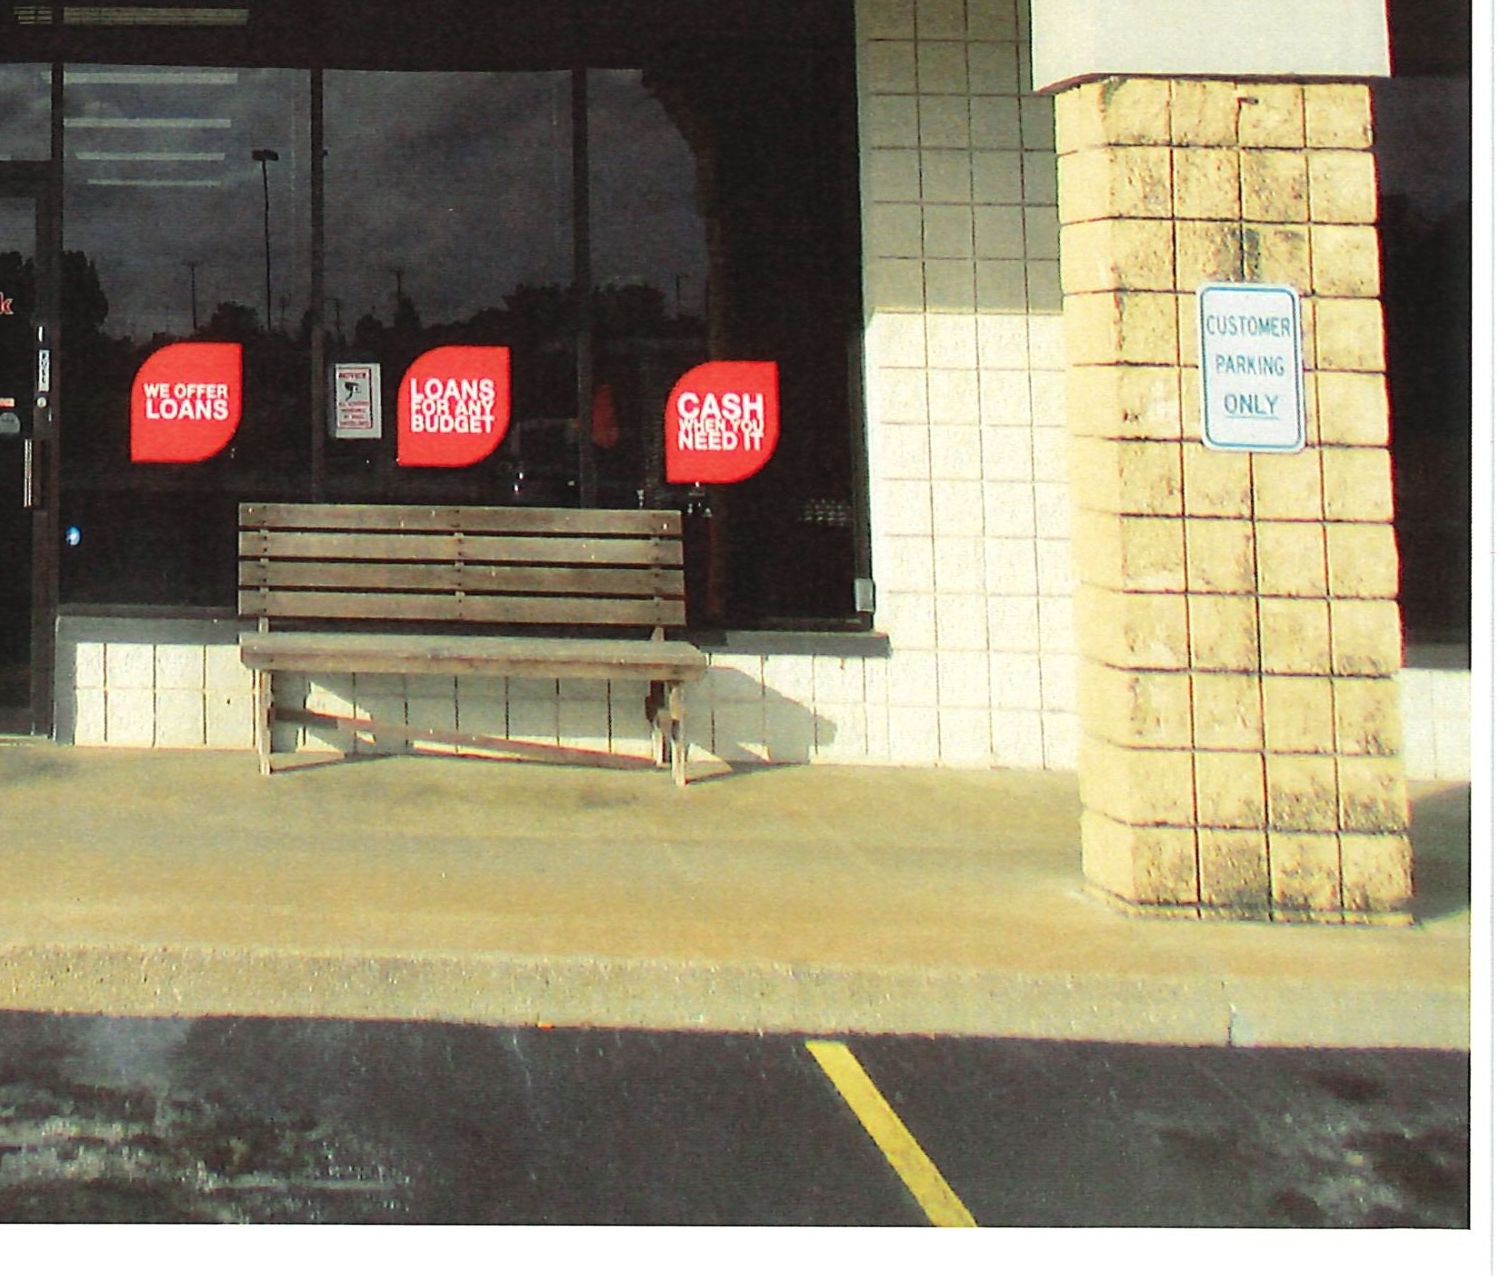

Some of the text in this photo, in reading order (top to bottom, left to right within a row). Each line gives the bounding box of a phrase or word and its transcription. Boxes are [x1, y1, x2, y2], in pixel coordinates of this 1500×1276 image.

[1206, 314, 1291, 338] CUSTOMER
[1215, 354, 1285, 376] PARKING
[143, 383, 228, 399] WE OFFER
[410, 377, 495, 400] LOANS
[145, 398, 229, 420] LOANS
[410, 398, 495, 417] FOR ANY
[677, 391, 764, 421] CASH
[1223, 393, 1279, 416] ONLY
[410, 414, 495, 433] BUDGET
[678, 417, 764, 433] WHEN YOU
[678, 430, 764, 451] NEED IT
